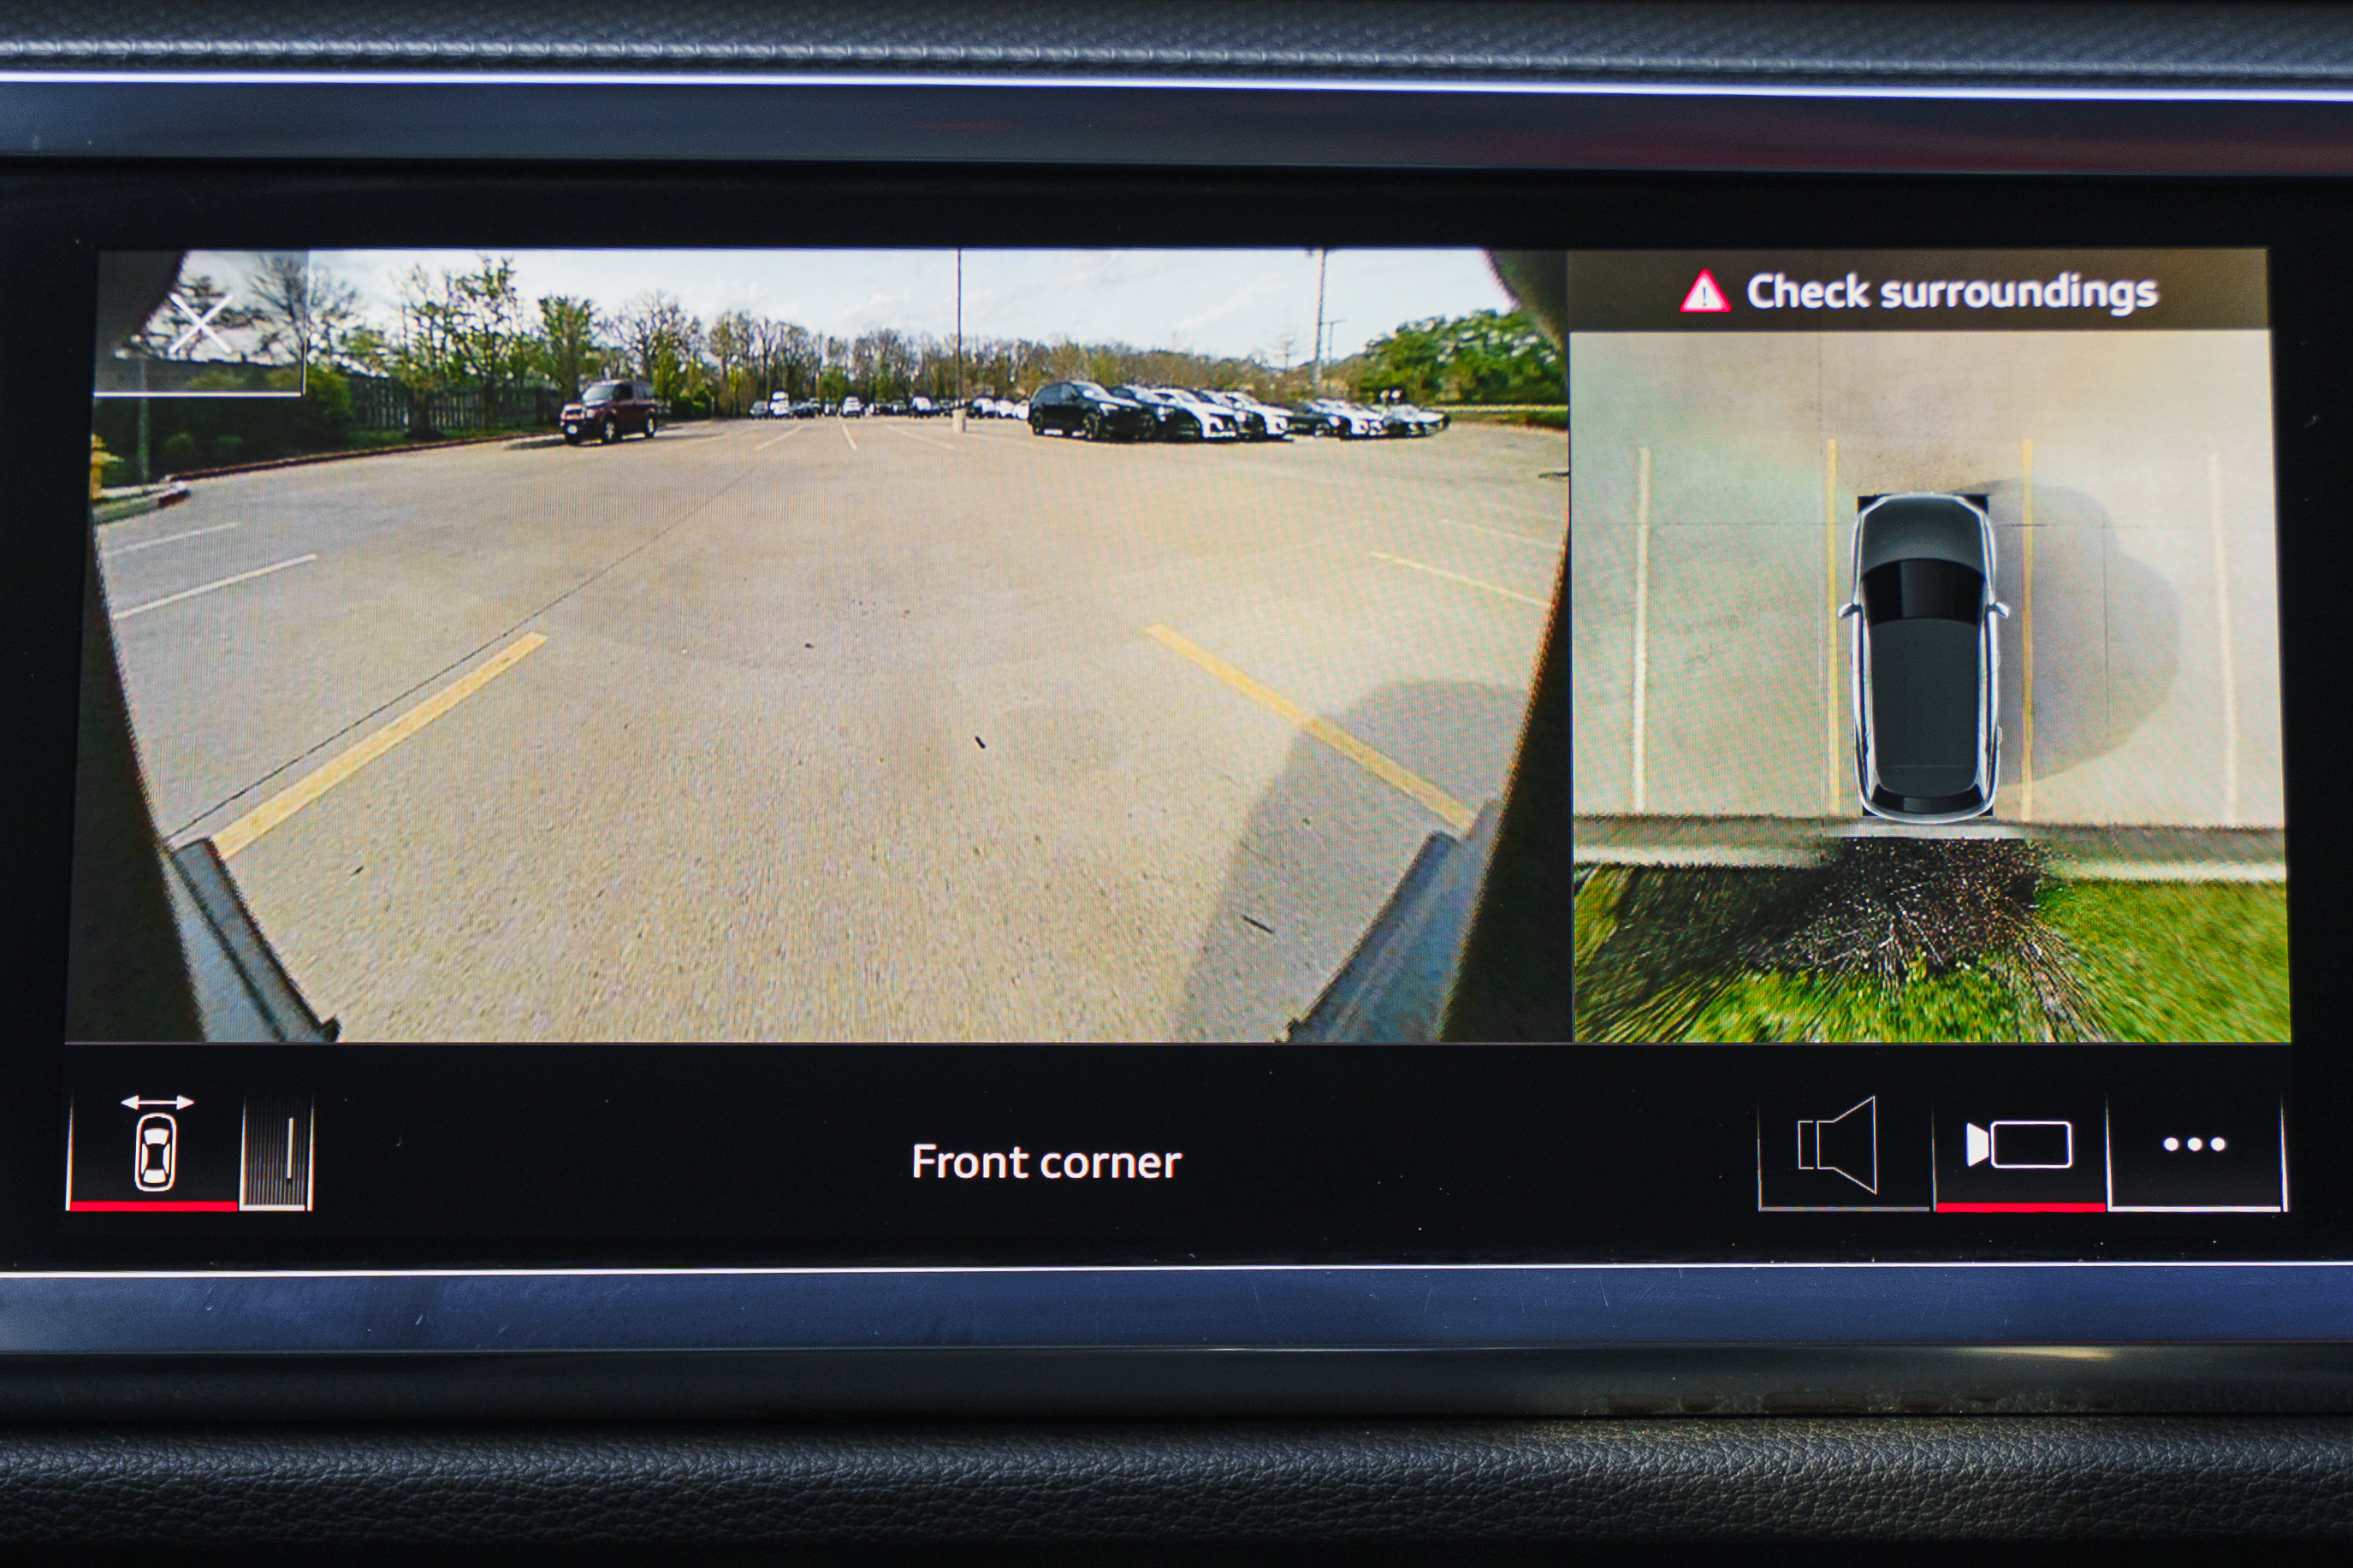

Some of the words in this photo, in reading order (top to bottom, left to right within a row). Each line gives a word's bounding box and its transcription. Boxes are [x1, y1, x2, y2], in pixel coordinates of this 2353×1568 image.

[1747, 272, 1871, 309] Check
[1881, 272, 2160, 317] surroundings
[912, 1143, 1029, 1179] Front
[1040, 1151, 1183, 1179] corner
